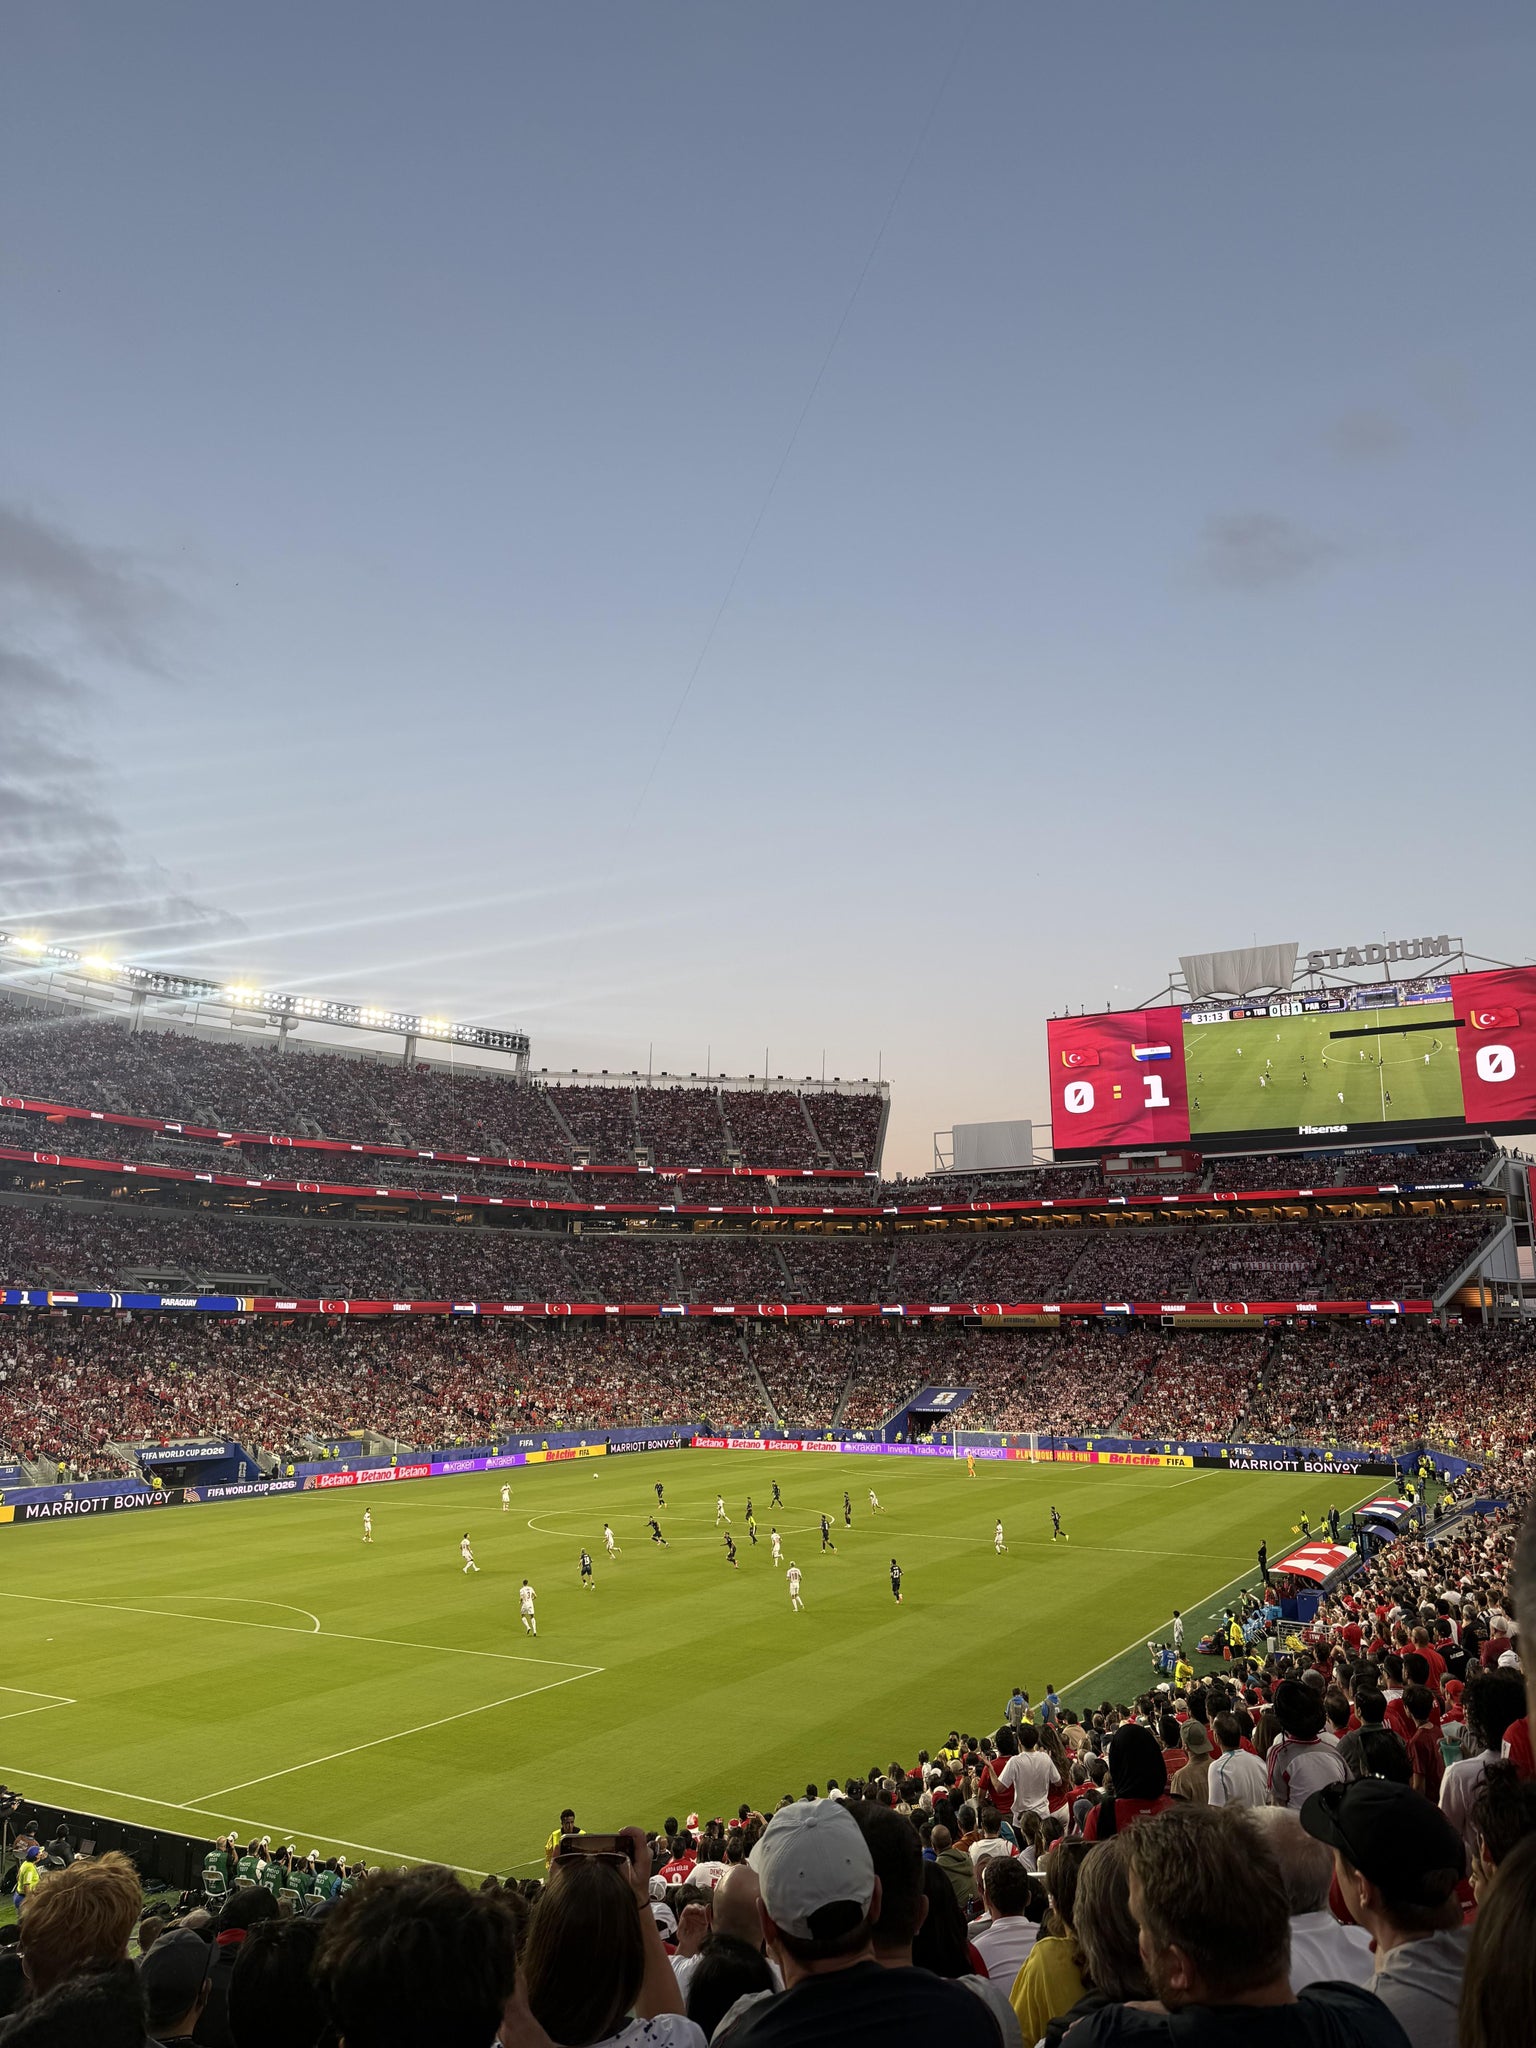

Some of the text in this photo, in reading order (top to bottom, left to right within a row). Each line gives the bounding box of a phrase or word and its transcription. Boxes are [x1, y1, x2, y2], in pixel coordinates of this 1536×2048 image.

[1307, 935, 1450, 971] STADIUM
[1252, 1008, 1266, 1016] TUR
[1304, 1002, 1319, 1011] PAR
[1197, 1012, 1223, 1023] 31:13
[1476, 1044, 1516, 1082] 0
[1064, 1081, 1095, 1113] 0
[1143, 1075, 1170, 1108] 1
[1298, 1125, 1348, 1135] Hisense
[20, 1291, 30, 1304] 1
[160, 1298, 197, 1307] PARAGUAY
[519, 1439, 534, 1447] FIFA
[610, 1438, 680, 1453] MARRIOTT BONVOY
[695, 1438, 724, 1447] Betano
[732, 1439, 761, 1448] Betano
[768, 1440, 799, 1449] Betano
[806, 1441, 837, 1451] Betano
[852, 1443, 882, 1452] kraken
[141, 1447, 225, 1460] FIFA WORLD CUP 2026
[972, 1448, 1003, 1456] kraken
[491, 1455, 516, 1466] kraken
[1109, 1453, 1160, 1465] Be Active
[1167, 1458, 1184, 1466] FIFA
[450, 1460, 475, 1471] kraken
[1229, 1459, 1358, 1474] MARRIOTT BONVOY
[362, 1469, 392, 1481] Betano
[399, 1466, 428, 1477] Betano
[320, 1474, 353, 1486] Betano
[207, 1480, 294, 1497] FIFA WORLD CUP 2026
[26, 1491, 171, 1518] MARRIOTT BONVOY
